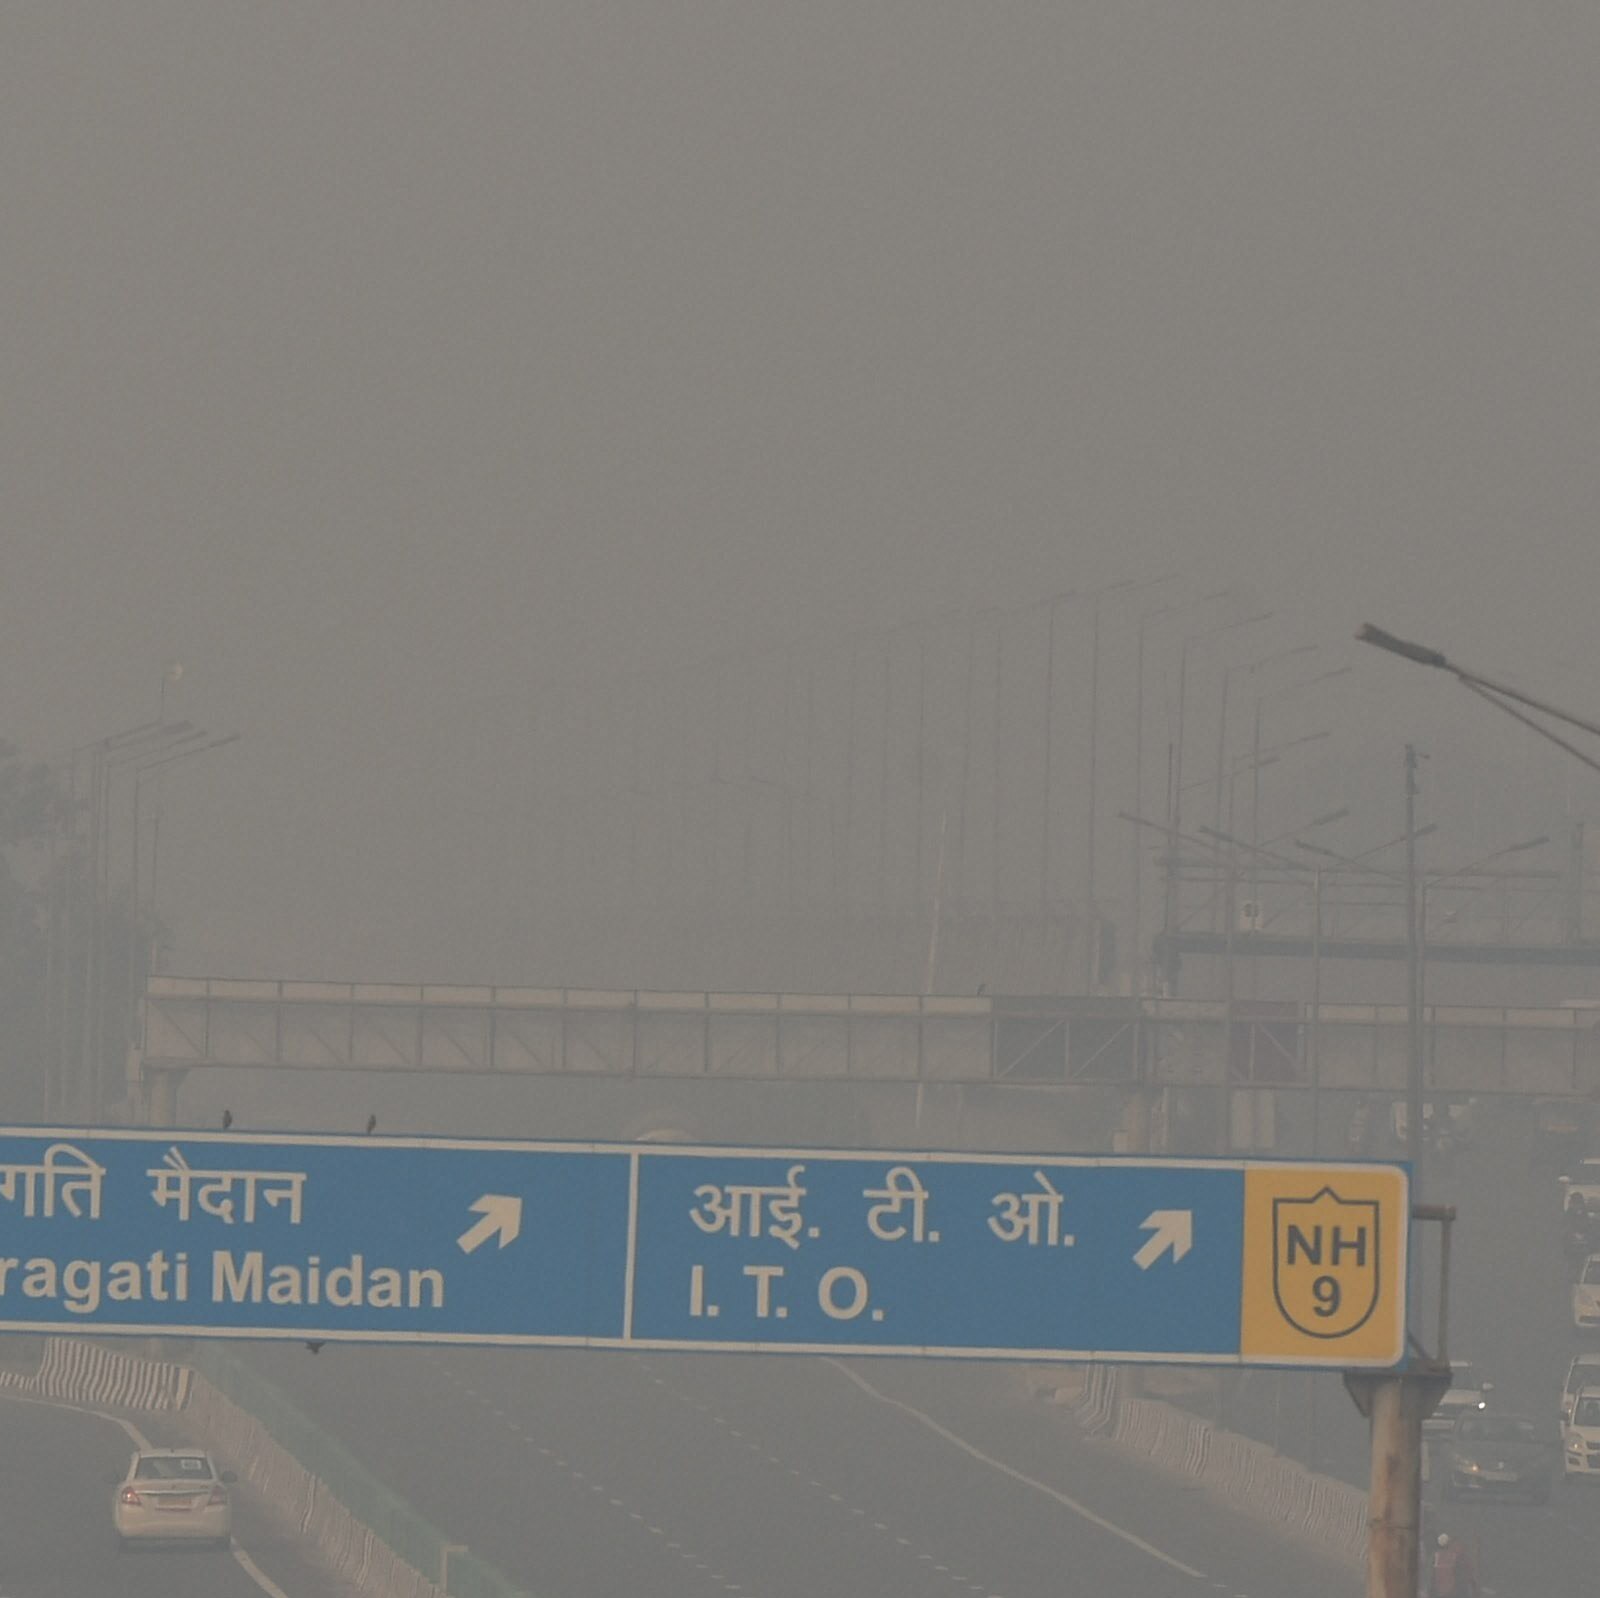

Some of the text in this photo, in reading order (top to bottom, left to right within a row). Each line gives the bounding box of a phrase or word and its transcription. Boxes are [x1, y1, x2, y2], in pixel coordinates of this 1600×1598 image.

[146, 1146, 307, 1224] मैदान
[689, 1165, 1076, 1249] आई. टी. ओ.
[1286, 1224, 1367, 1267] NH
[212, 1250, 444, 1308] Maidan
[689, 1265, 884, 1321] I. T. O.
[1312, 1275, 1342, 1318] 9
